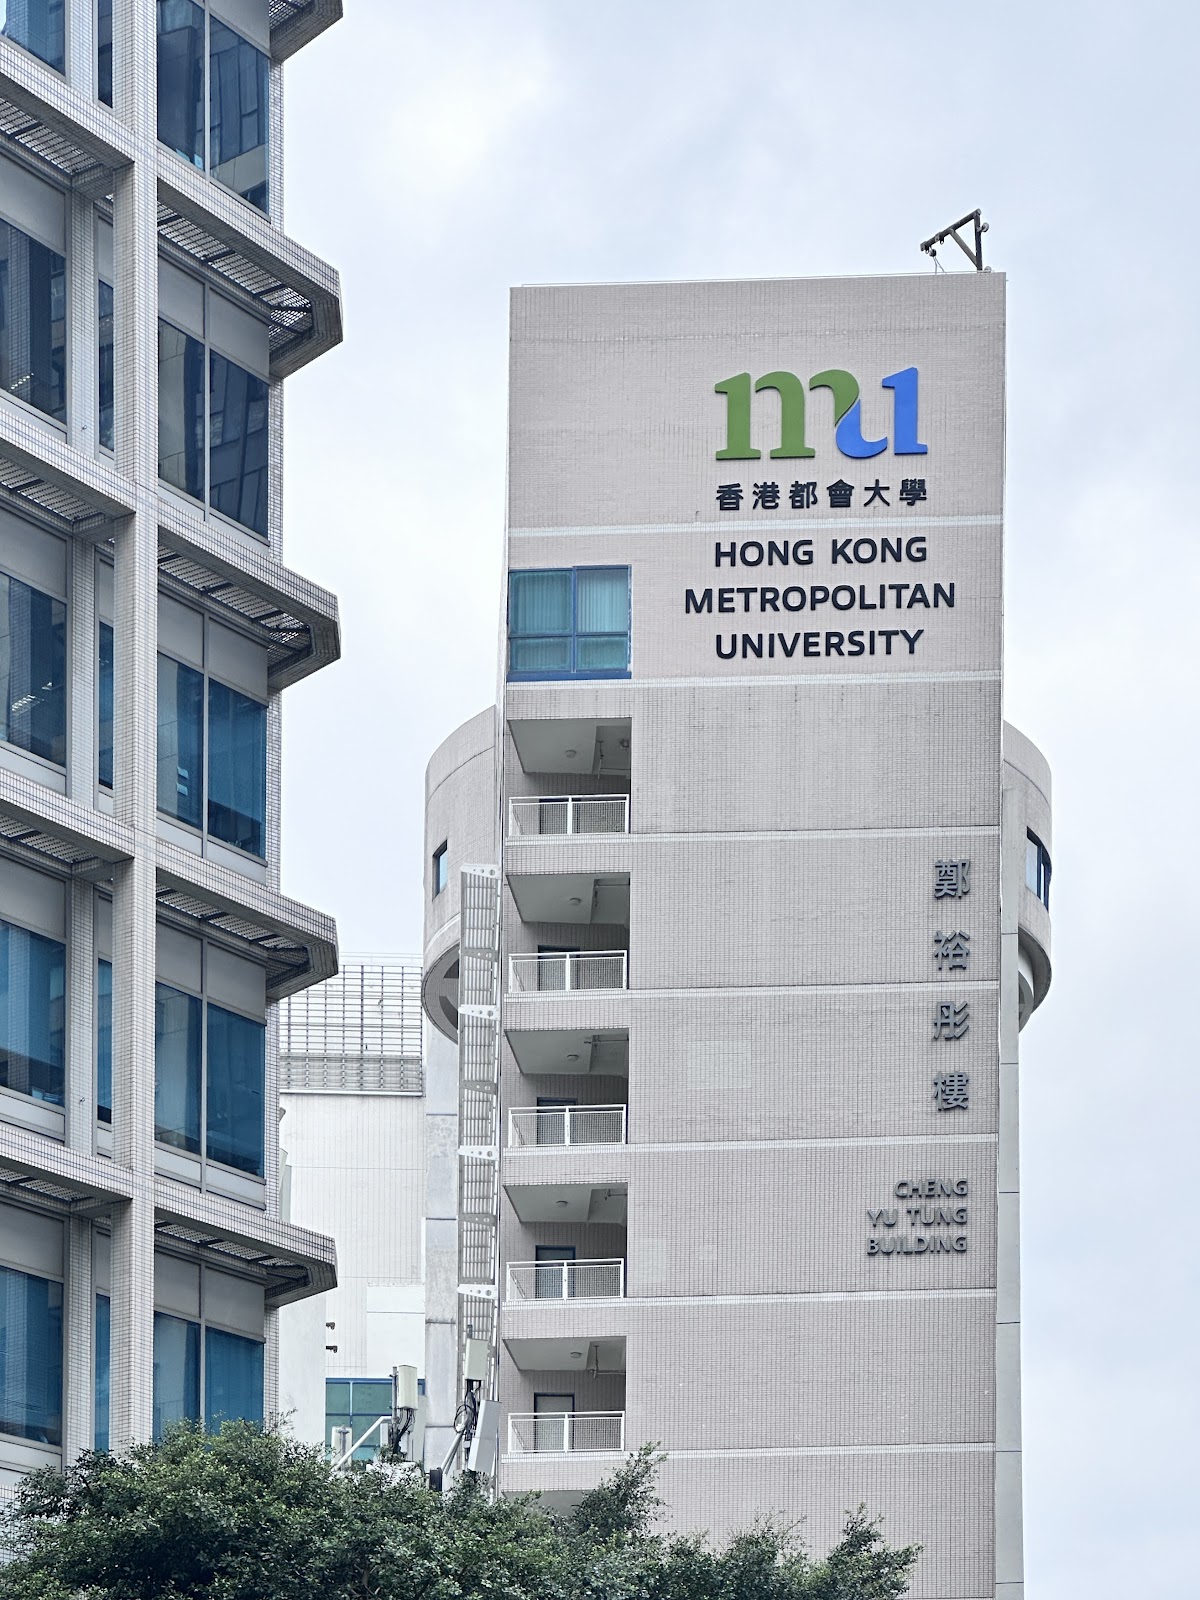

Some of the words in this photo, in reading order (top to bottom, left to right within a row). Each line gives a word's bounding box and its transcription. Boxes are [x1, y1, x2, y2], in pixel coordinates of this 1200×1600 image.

[716, 478, 927, 511] 香港都會大學
[715, 539, 814, 567] HONG
[831, 536, 927, 564] KONG
[685, 582, 955, 614] METROPOLITAN
[715, 629, 925, 659] UNIVERSITY
[933, 858, 971, 1112] 鄭裕彤樓
[895, 1178, 968, 1198] CHENG
[867, 1208, 897, 1226] YU
[906, 1206, 968, 1226] TUNG
[866, 1234, 968, 1256] BUILDING
